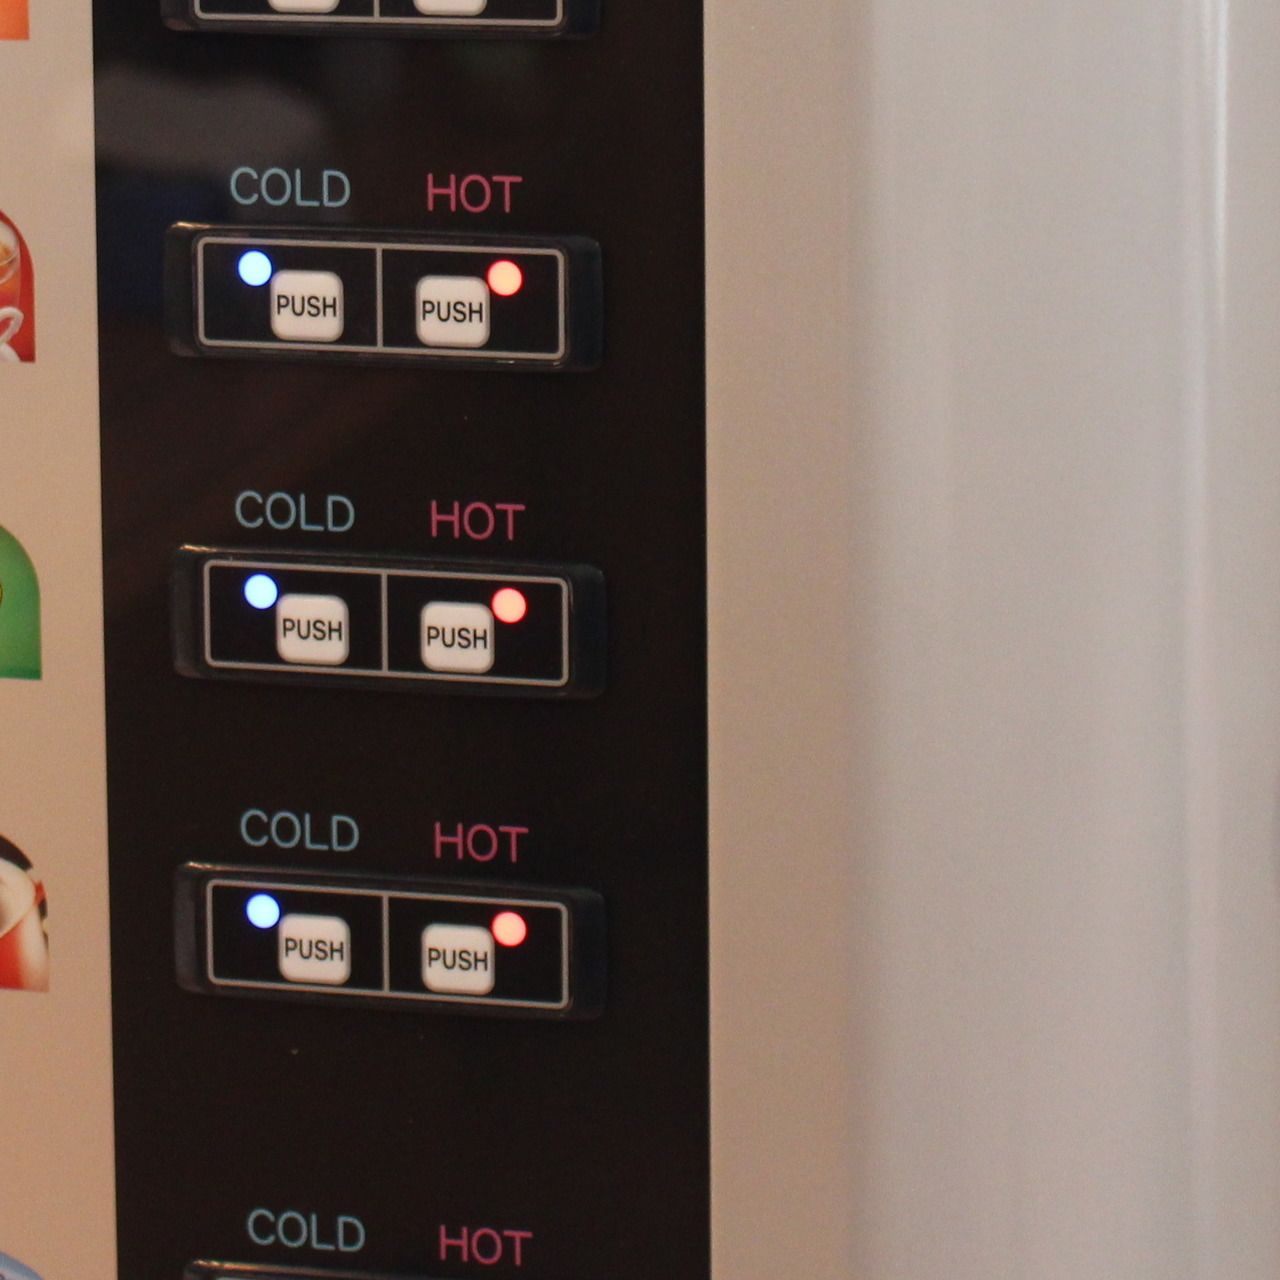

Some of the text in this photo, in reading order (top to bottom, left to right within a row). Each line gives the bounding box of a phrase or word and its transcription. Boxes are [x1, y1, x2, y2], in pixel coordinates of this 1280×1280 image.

[230, 166, 351, 208] COLD
[426, 173, 523, 213] HOT
[276, 294, 337, 318] PUSH
[421, 300, 483, 323] PUSH
[235, 490, 355, 533] COLD
[430, 500, 526, 540] HOT
[282, 618, 343, 642] PUSH
[426, 626, 488, 649] PUSH
[240, 808, 360, 852] COLD
[434, 821, 529, 863] HOT
[284, 937, 345, 961] PUSH
[428, 947, 489, 972] PUSH
[247, 1208, 366, 1252] COLD
[439, 1224, 533, 1267] HOT
